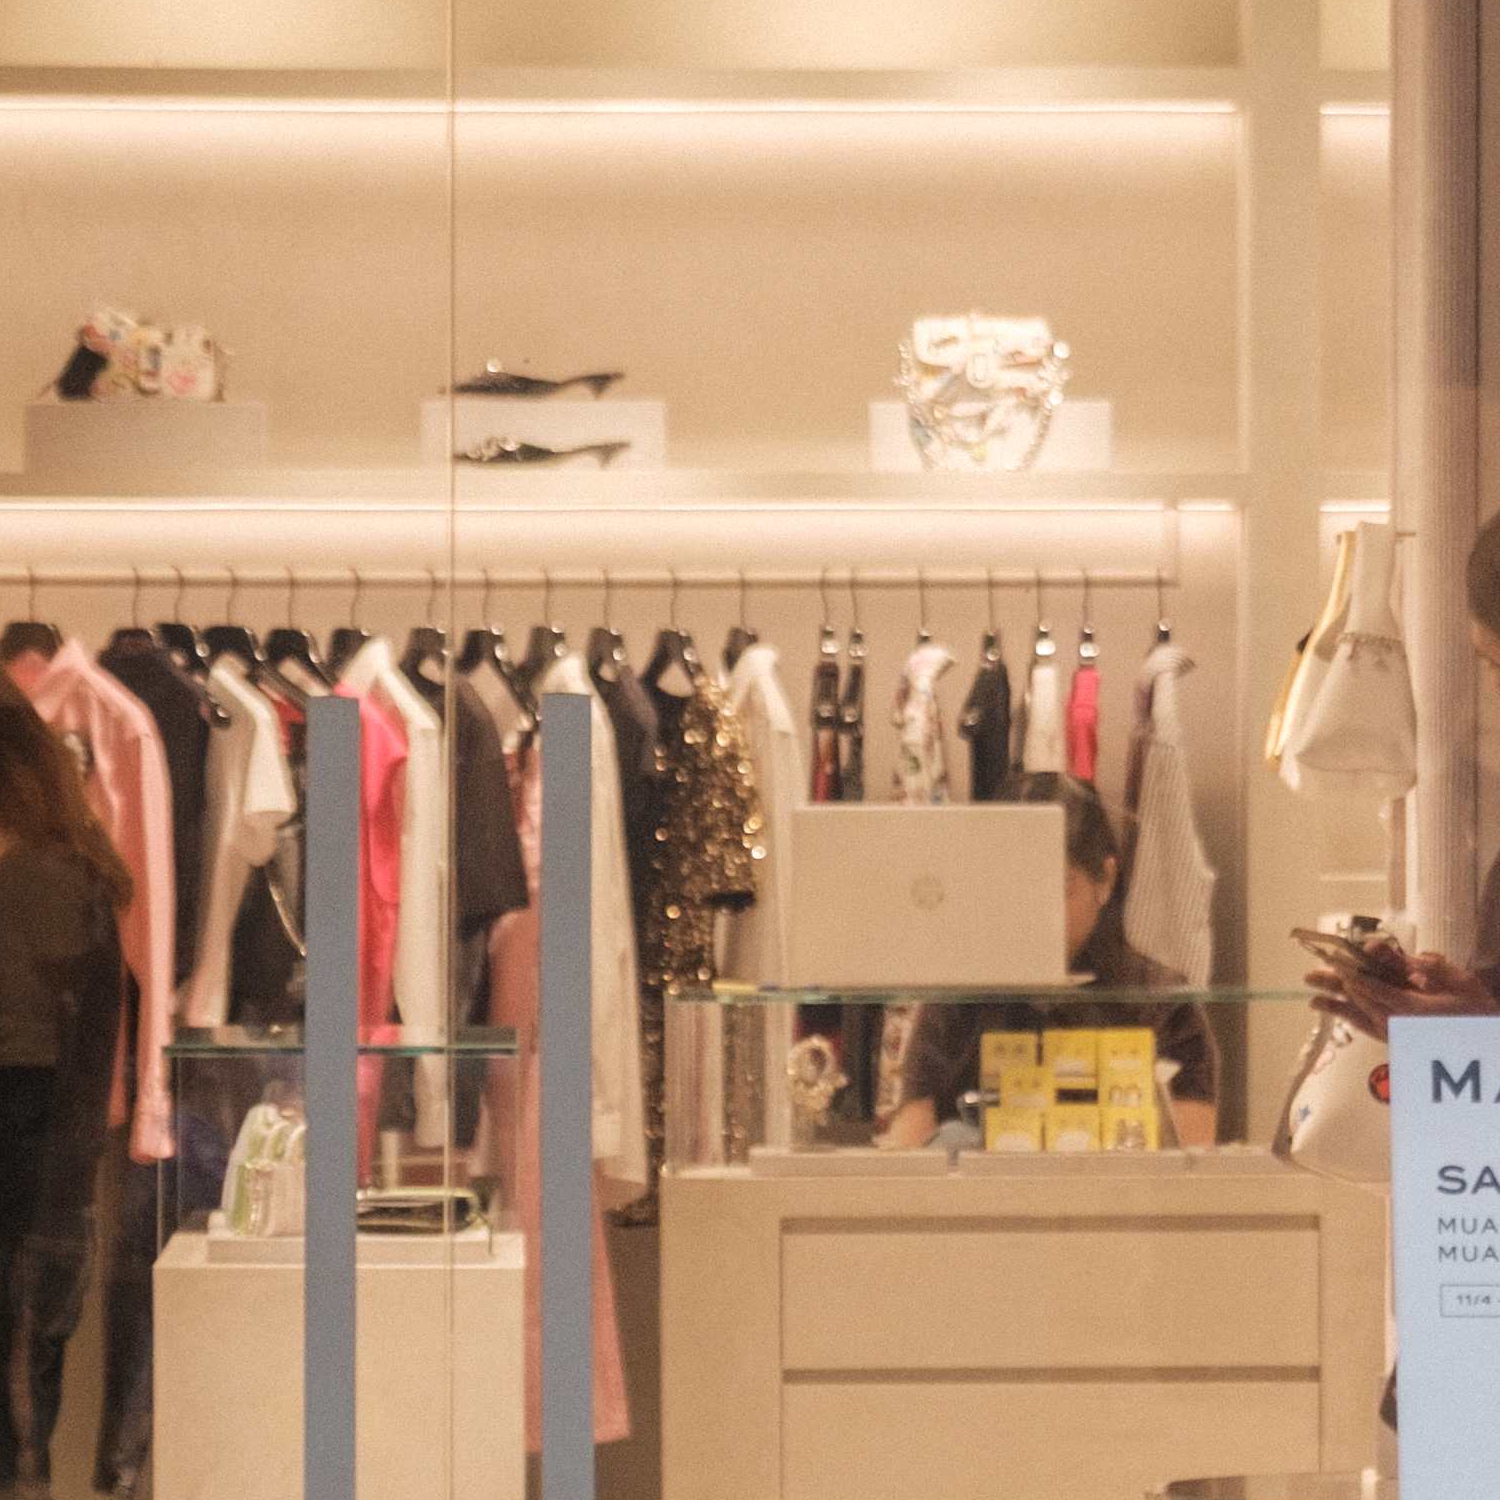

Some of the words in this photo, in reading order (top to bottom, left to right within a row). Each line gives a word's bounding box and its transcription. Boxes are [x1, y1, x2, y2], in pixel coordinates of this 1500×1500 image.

[1437, 1216, 1498, 1235] MUA
[1438, 1245, 1499, 1263] MUA
[1457, 1294, 1491, 1306] 11/4
